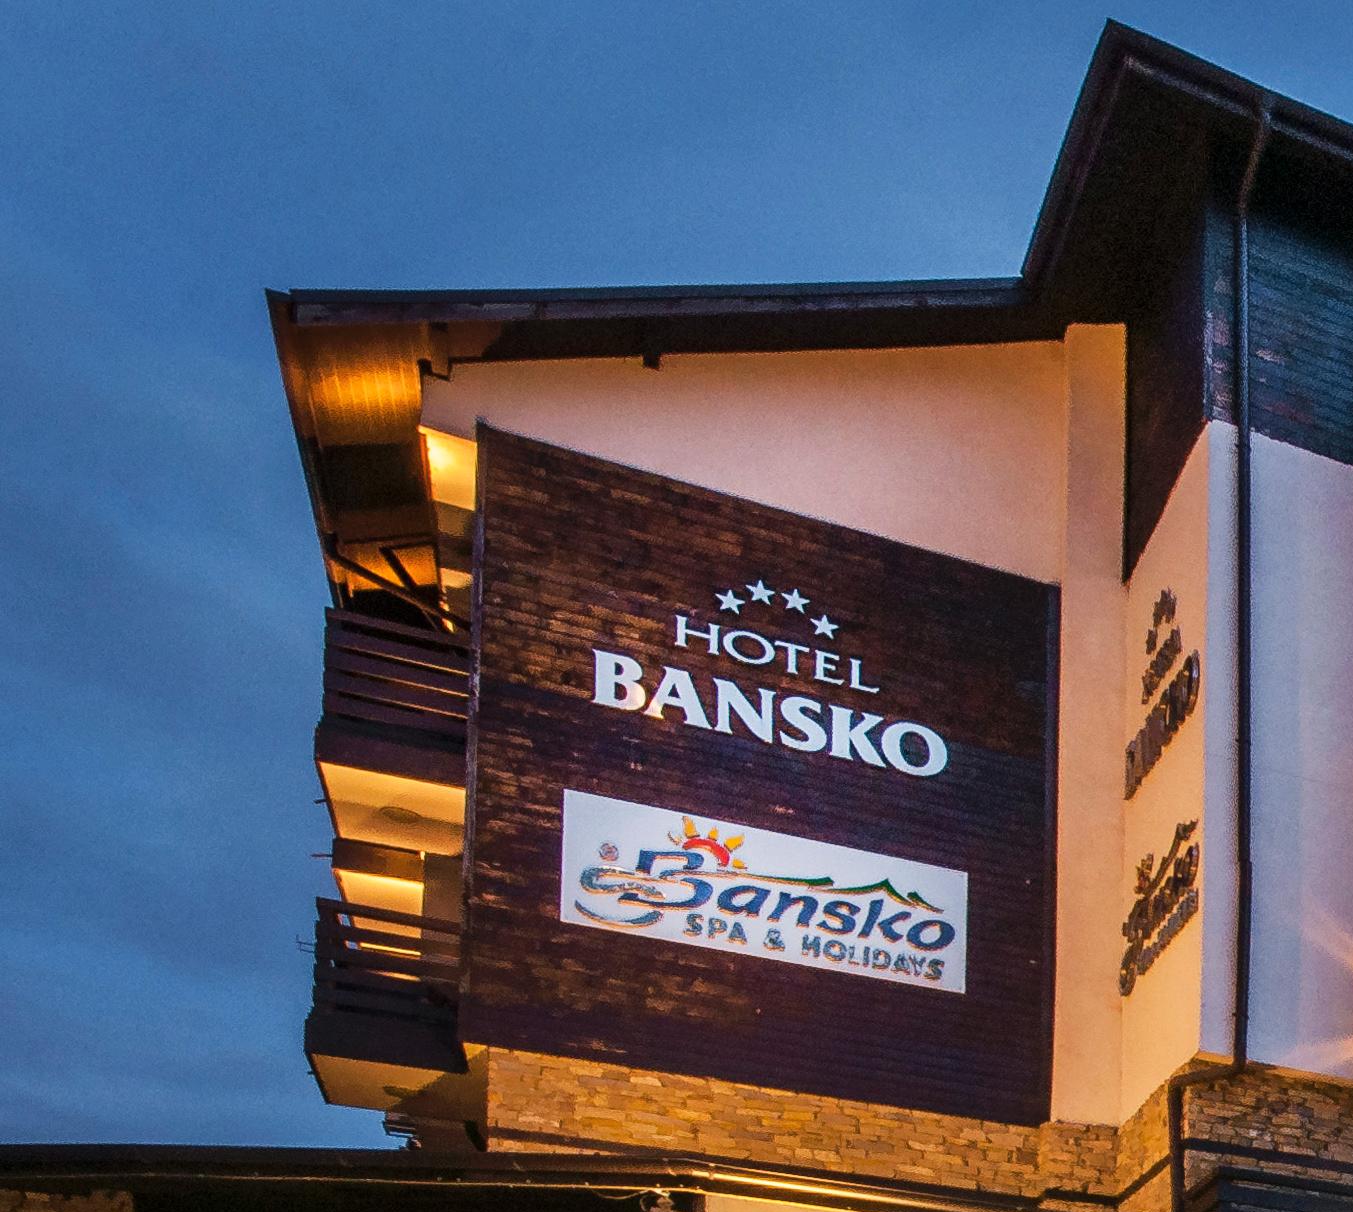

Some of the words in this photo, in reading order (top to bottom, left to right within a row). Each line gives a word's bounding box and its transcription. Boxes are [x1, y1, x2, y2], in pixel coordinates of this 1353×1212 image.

[674, 615, 880, 693] HOTEL
[592, 649, 949, 777] BANSKO
[617, 848, 956, 952] Bansko
[683, 913, 748, 945] SPA
[763, 929, 786, 952] &
[801, 934, 946, 981] HOLIDAYS
